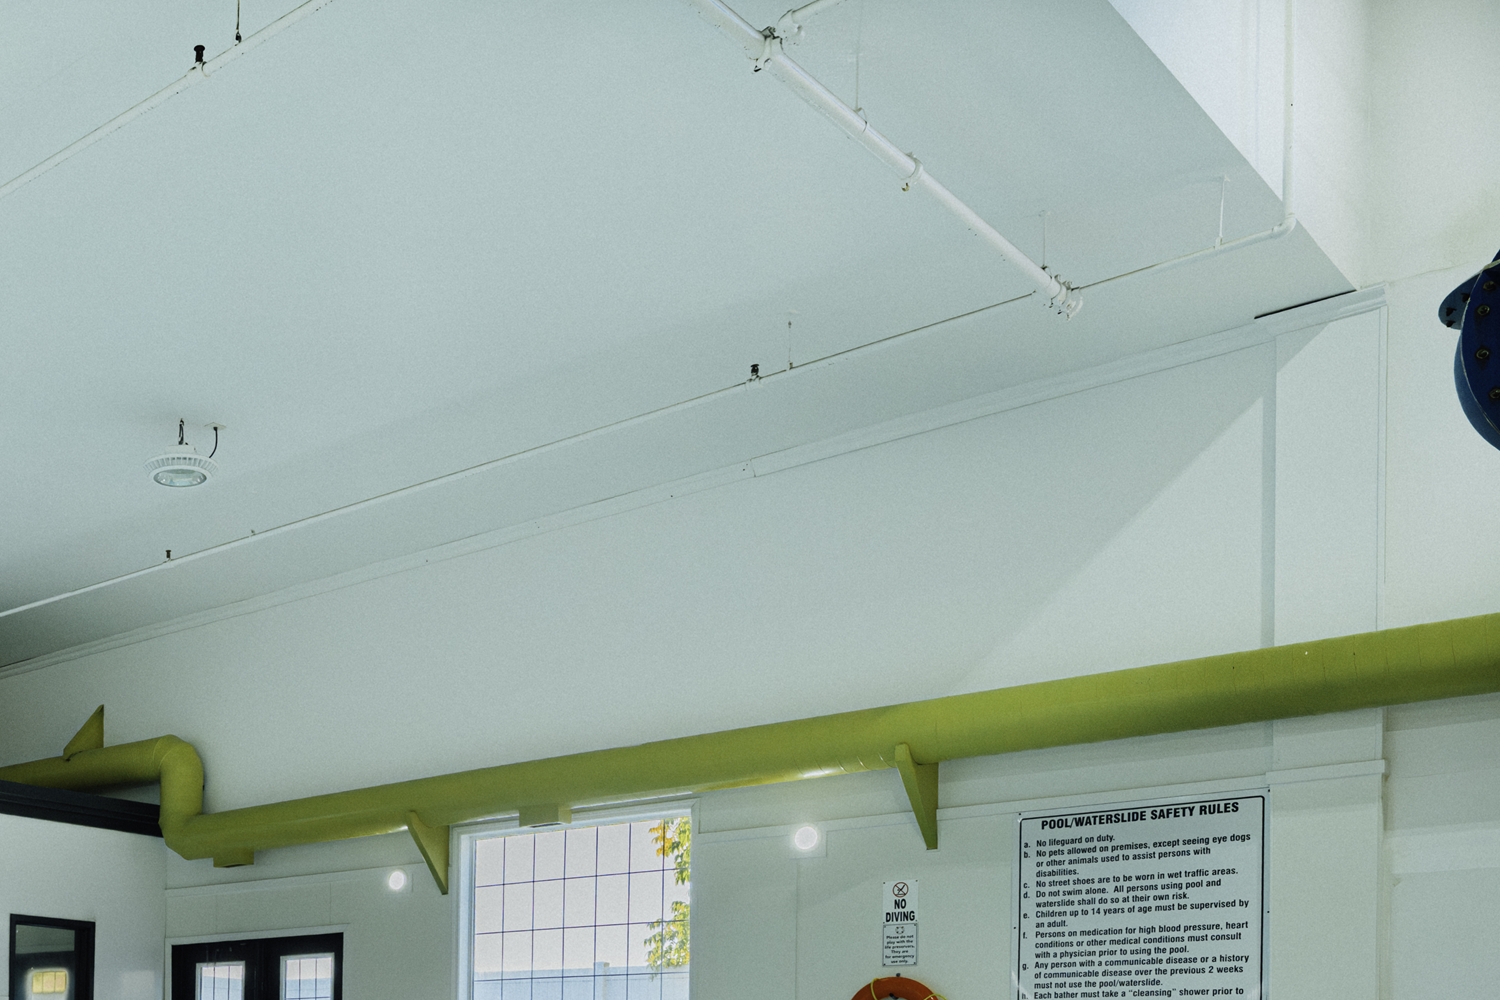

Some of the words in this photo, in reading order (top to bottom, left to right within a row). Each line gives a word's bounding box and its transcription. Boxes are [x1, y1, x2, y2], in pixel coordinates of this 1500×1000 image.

[1040, 811, 1147, 830] POOL/WATERSLIDE
[1150, 806, 1195, 820] SAFETY
[1198, 801, 1239, 816] RULES
[1023, 841, 1031, 849] a.
[1036, 839, 1047, 847] No
[1048, 835, 1083, 847] lifeguard
[1096, 833, 1115, 843] duty.
[1035, 879, 1047, 888] No
[1047, 878, 1071, 887] street
[1071, 877, 1095, 886] shoes
[1097, 876, 1111, 884] are
[1112, 875, 1121, 883] to
[1122, 874, 1133, 882] be
[1134, 873, 1155, 881] worn
[1157, 871, 1165, 880] in
[1166, 870, 1182, 879] wet
[1183, 868, 1209, 878] traffic
[1211, 867, 1238, 876] areas.
[894, 898, 907, 909] NO
[1035, 909, 1067, 919] Children
[1069, 909, 1079, 918] up
[1080, 908, 1089, 916] to
[1090, 907, 1101, 915] 14
[1102, 907, 1125, 916] years
[1126, 904, 1136, 914] of
[1137, 905, 1152, 914] age
[1154, 903, 1175, 912] must
[1177, 902, 1188, 911] be
[1189, 899, 1236, 911] supervised
[1238, 898, 1250, 908] by
[885, 910, 915, 922] DIVING
[1035, 921, 1045, 929] an
[1046, 919, 1068, 928] adult.
